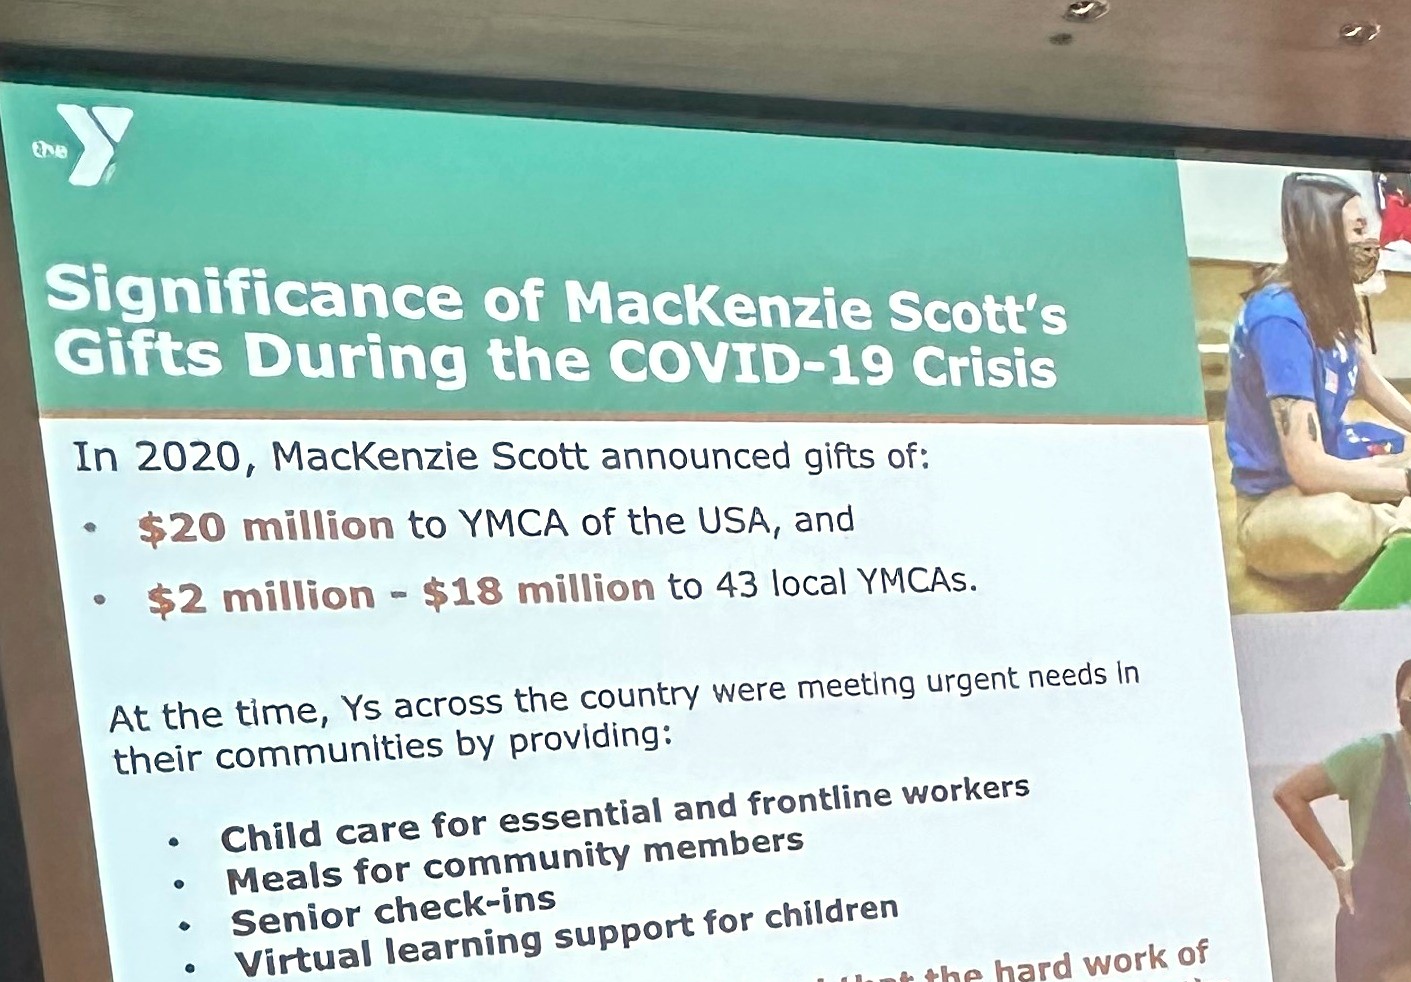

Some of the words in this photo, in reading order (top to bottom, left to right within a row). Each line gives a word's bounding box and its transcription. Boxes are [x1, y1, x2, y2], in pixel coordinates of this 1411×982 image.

[45, 263, 464, 324] Significance
[484, 277, 545, 322] of
[565, 280, 873, 331] MacKenzie
[54, 326, 223, 377] Gifts
[244, 332, 467, 391] During
[486, 335, 590, 382] the
[609, 339, 894, 386] COVID-19
[912, 345, 1057, 389] Crisis
[72, 440, 118, 472] In
[135, 439, 256, 479] 2020,
[271, 440, 479, 472] MacKenzie
[491, 441, 590, 471] Scott
[601, 439, 791, 471] announced
[804, 441, 876, 476] gifts
[887, 441, 929, 470] of:
[138, 510, 226, 551] $20
[242, 509, 395, 542] million
[407, 509, 447, 540] to
[457, 507, 570, 539] YMCA
[581, 506, 617, 537] of
[626, 505, 687, 536] the
[698, 505, 781, 541] USA,
[794, 503, 855, 533] and
[147, 582, 208, 622] $2
[222, 579, 376, 613] million
[423, 575, 504, 614] $18
[517, 572, 656, 605] million
[667, 572, 703, 601] to
[716, 570, 759, 599] 43
[771, 566, 847, 598] local
[856, 566, 977, 595] YMCAs.
[108, 704, 152, 734] At
[161, 700, 224, 731] the
[234, 697, 329, 730] time,
[340, 693, 383, 722] Ys
[394, 693, 503, 720] across
[513, 685, 569, 714] the
[580, 681, 700, 711] country
[712, 681, 787, 704] were
[797, 670, 916, 700] meeting
[926, 666, 1021, 698] urgent
[1028, 661, 1108, 689] needs
[1116, 659, 1140, 685] in
[111, 744, 203, 776] their
[215, 732, 444, 770] communities
[455, 728, 496, 762] by
[509, 721, 672, 761] providing:
[220, 819, 322, 854] Child
[335, 819, 421, 846] care
[430, 810, 487, 839] for
[499, 796, 663, 834] essential
[673, 791, 738, 822] and
[746, 784, 893, 817] frontline
[901, 776, 1031, 805] workers
[226, 860, 343, 896] Meals
[352, 856, 411, 886] for
[422, 840, 631, 880] community
[643, 829, 805, 863] members
[230, 902, 361, 937] Senior
[373, 886, 557, 925] check-ins
[233, 938, 372, 978] Virtual
[385, 928, 542, 965] learning
[554, 912, 696, 952] support
[702, 908, 755, 936] for
[764, 897, 899, 929] children
[1082, 943, 1169, 977] work
[1177, 937, 1209, 967] of
